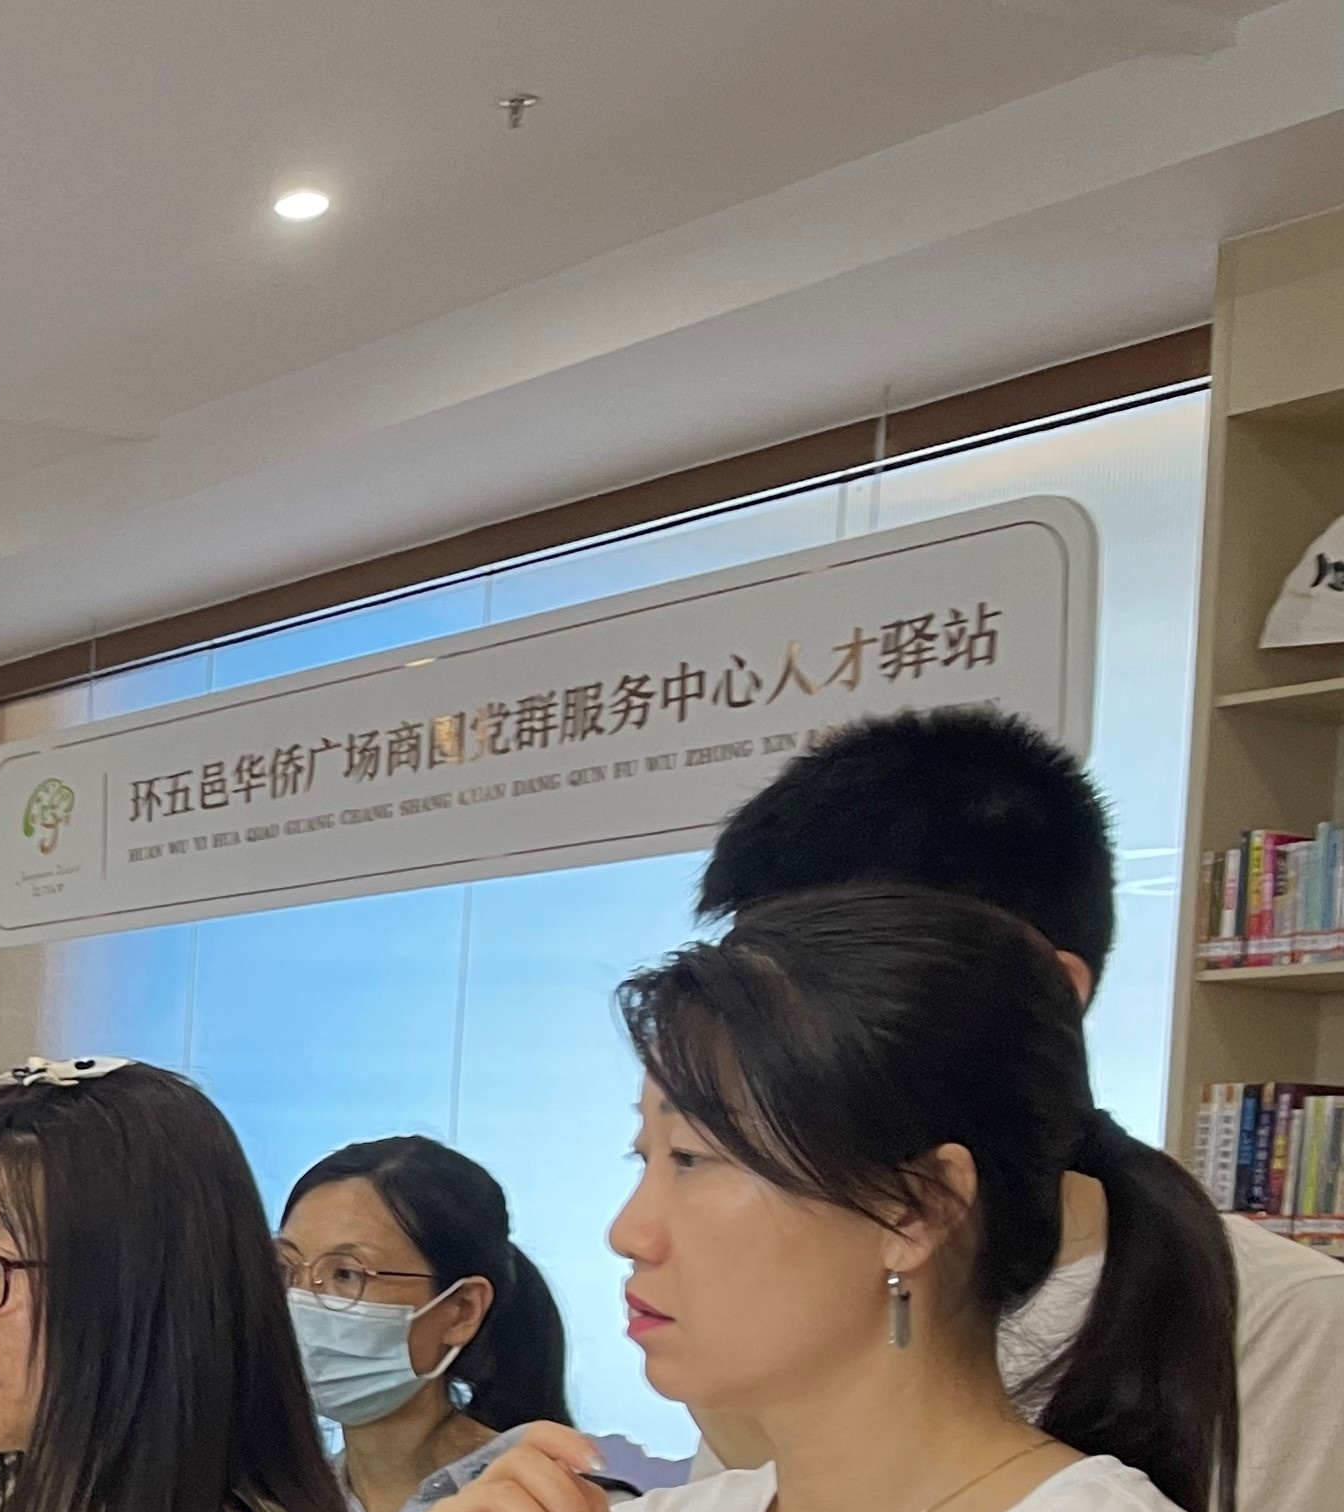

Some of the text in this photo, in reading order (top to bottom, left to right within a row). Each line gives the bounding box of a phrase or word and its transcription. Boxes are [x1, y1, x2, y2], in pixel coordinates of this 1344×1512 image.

[129, 601, 1003, 823] 环五邑华侨广场商圈党群服务中心人才驿站
[283, 813, 336, 836] GUANG
[339, 803, 394, 826] CHANG
[398, 792, 452, 817] SHANG
[511, 773, 562, 797] DANG
[645, 752, 679, 772] WU
[684, 739, 754, 767] ZHONG
